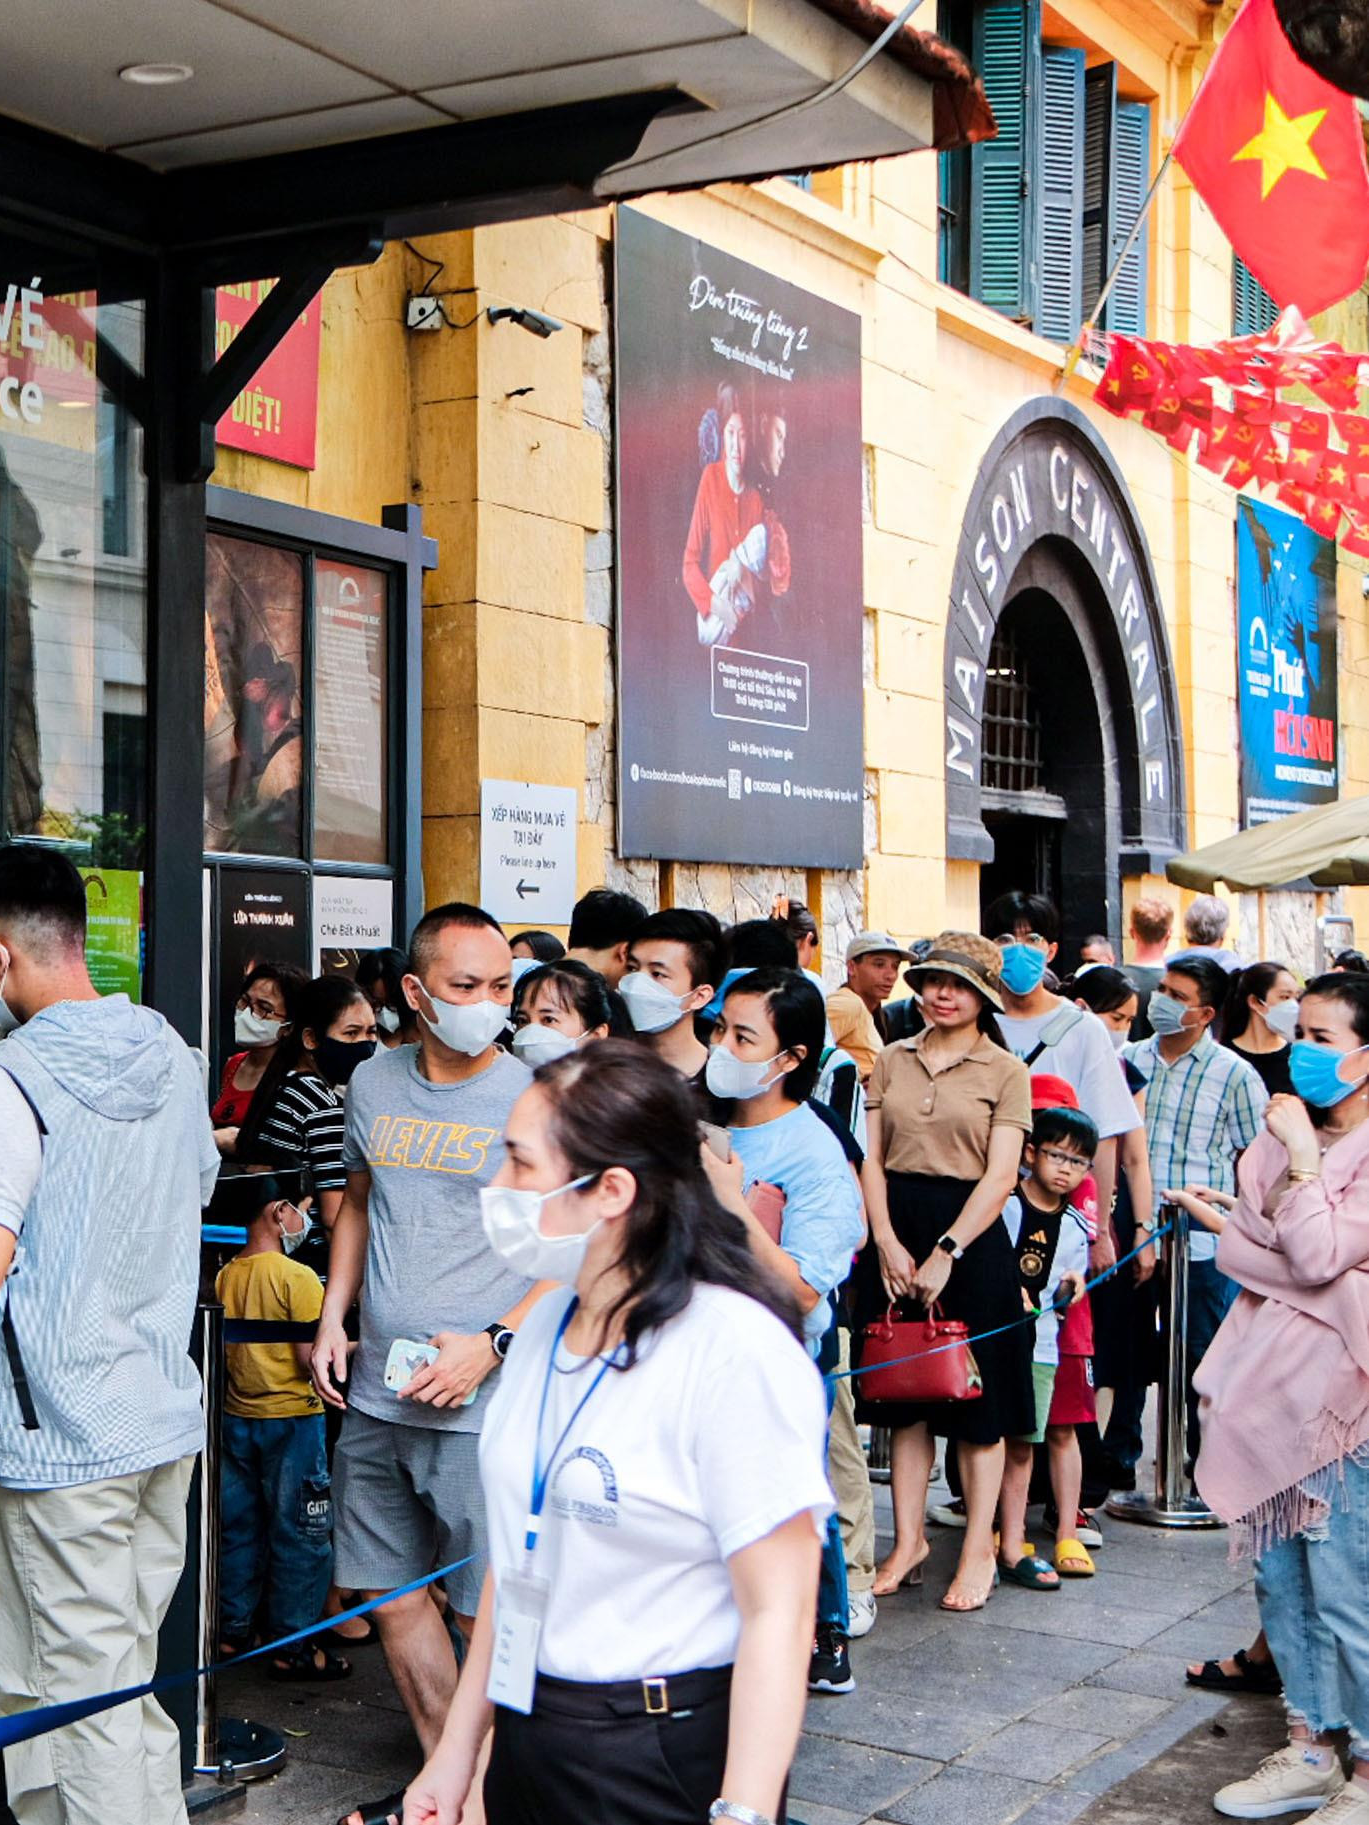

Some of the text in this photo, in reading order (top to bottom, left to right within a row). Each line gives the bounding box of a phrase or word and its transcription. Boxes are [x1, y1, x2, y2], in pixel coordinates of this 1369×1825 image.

[796, 327, 808, 350] 2
[946, 464, 1033, 782] MAISON
[1050, 445, 1164, 803] CENTRALE
[1302, 714, 1334, 763] SINH
[491, 803, 508, 823] XẾP
[534, 811, 553, 827] MUA
